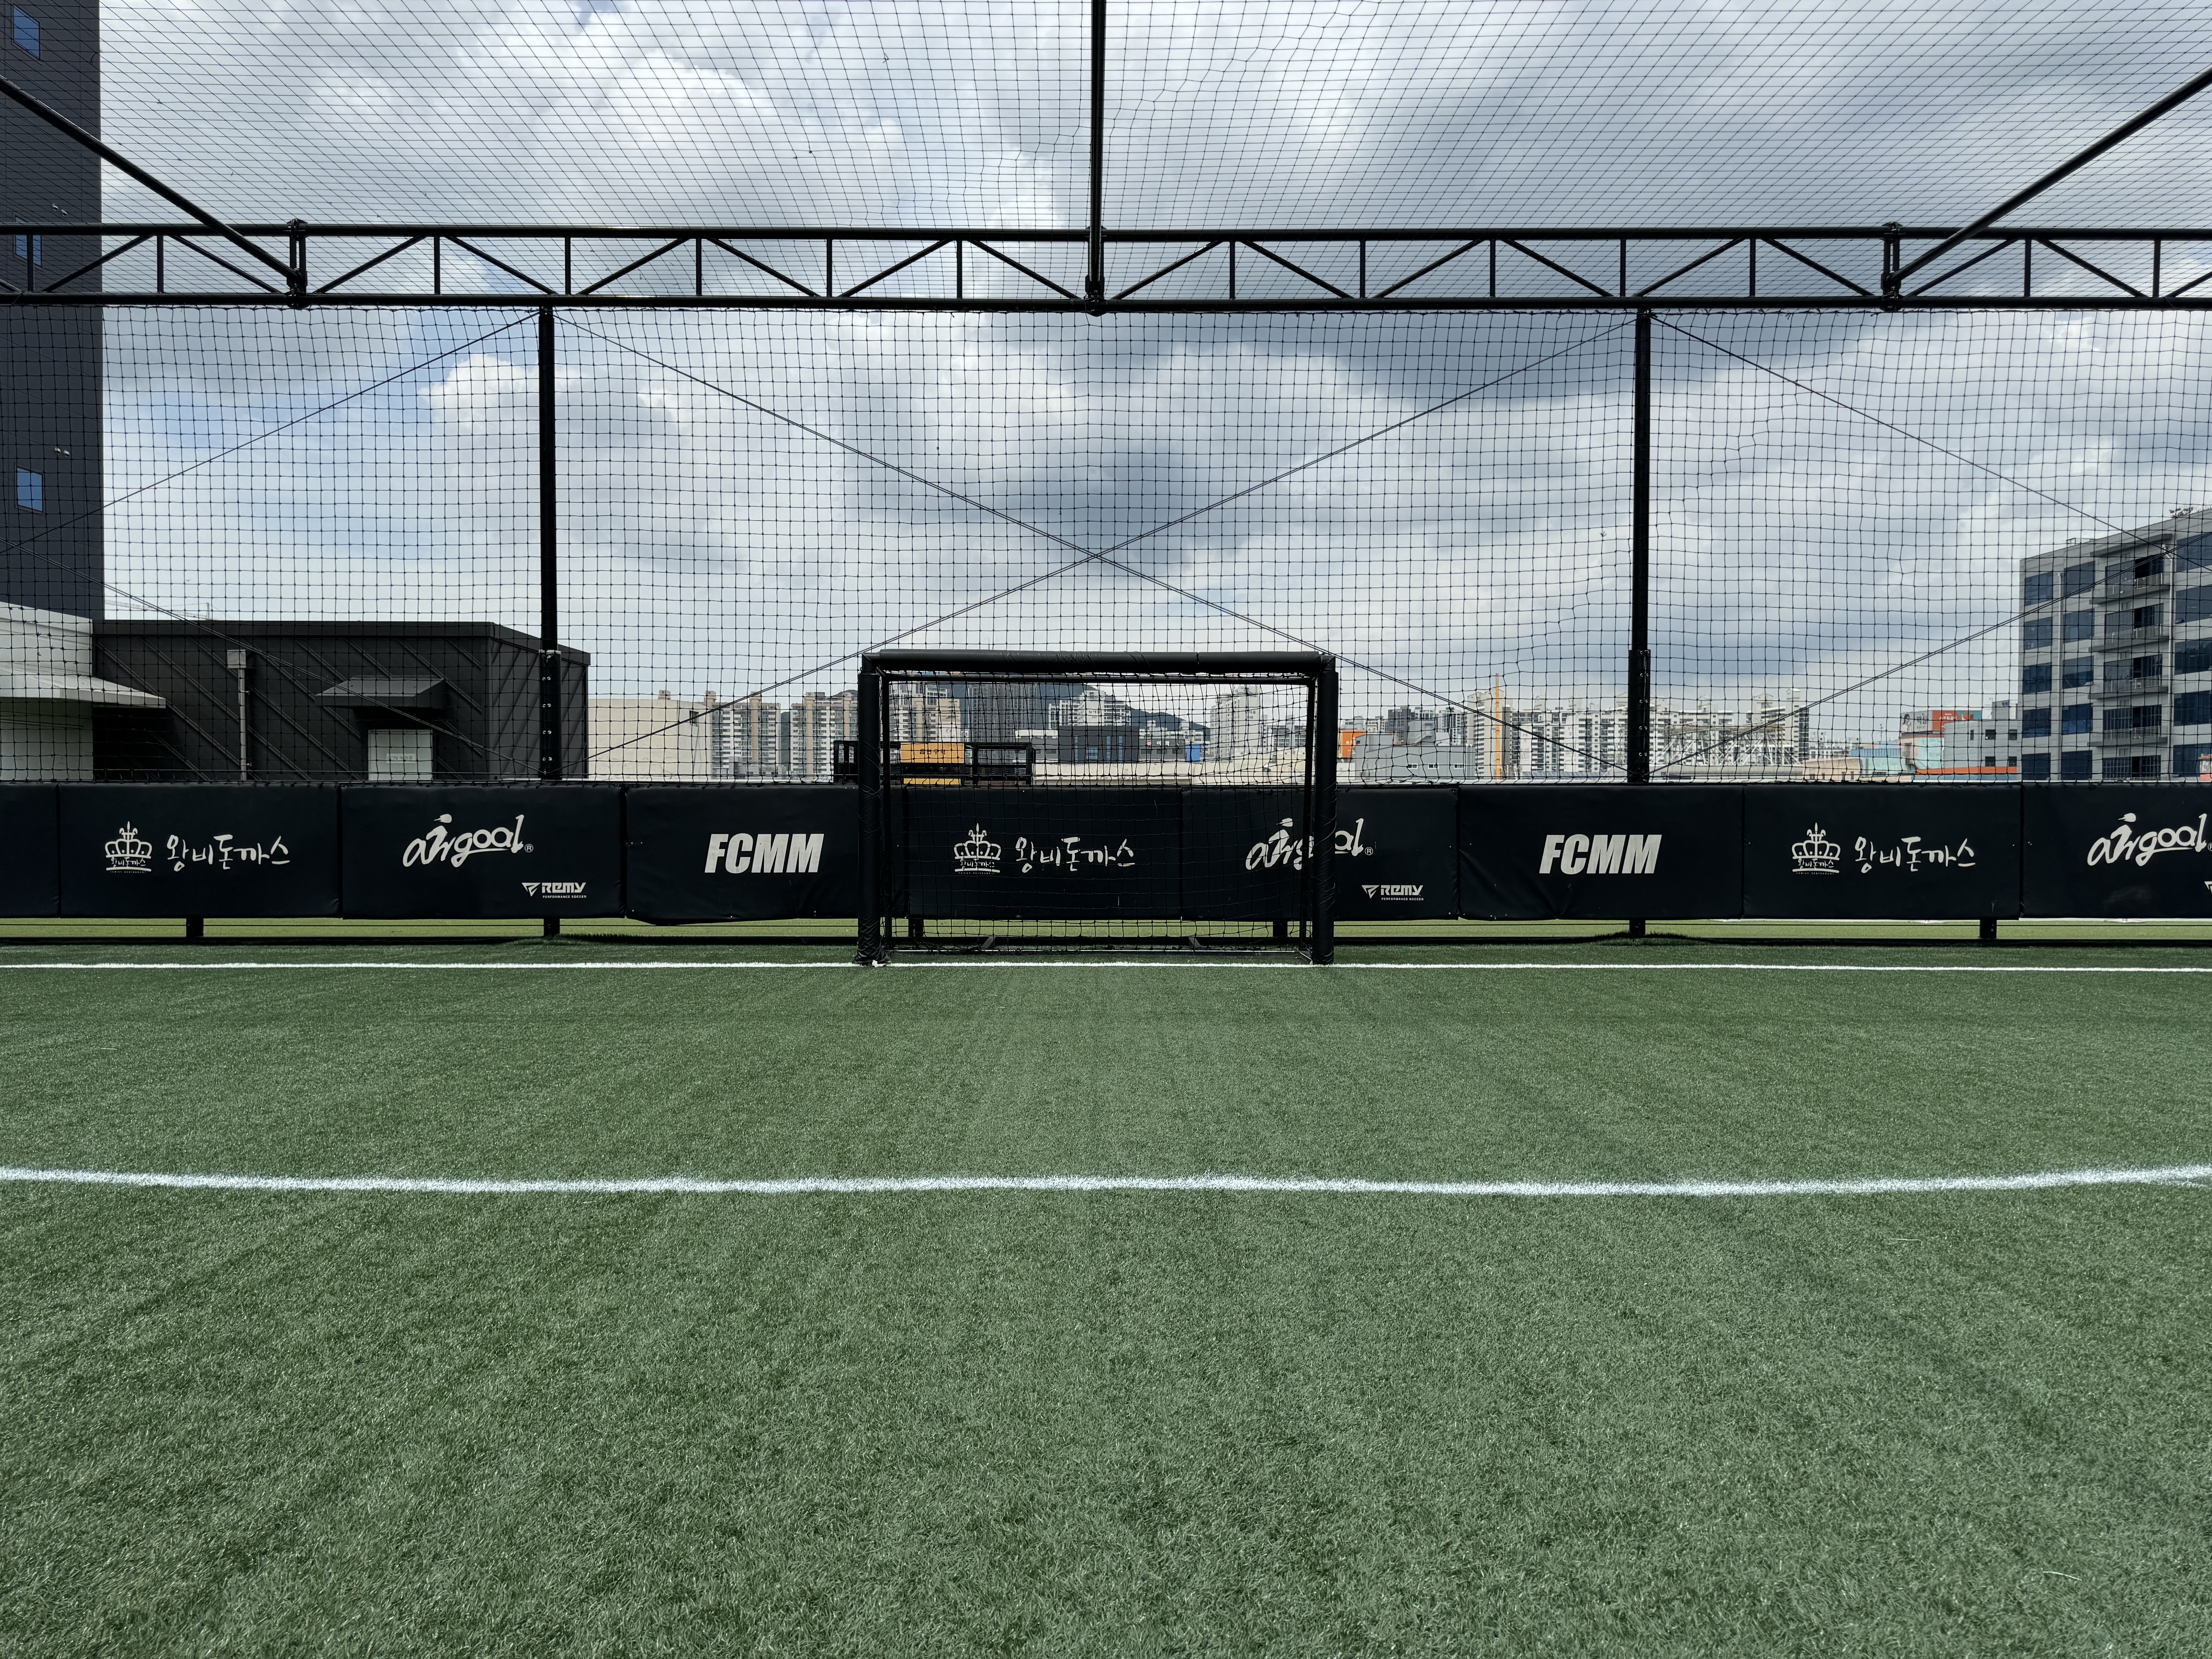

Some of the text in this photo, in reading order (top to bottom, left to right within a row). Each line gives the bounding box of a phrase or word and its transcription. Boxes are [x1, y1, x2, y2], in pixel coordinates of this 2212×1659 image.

[167, 834, 290, 872] 왕비돈까스
[705, 833, 824, 874] FCMM
[1015, 836, 1135, 873] 왕비돈까스
[1539, 834, 1662, 874] FCMM
[1855, 836, 1976, 874] 왕비돈까스
